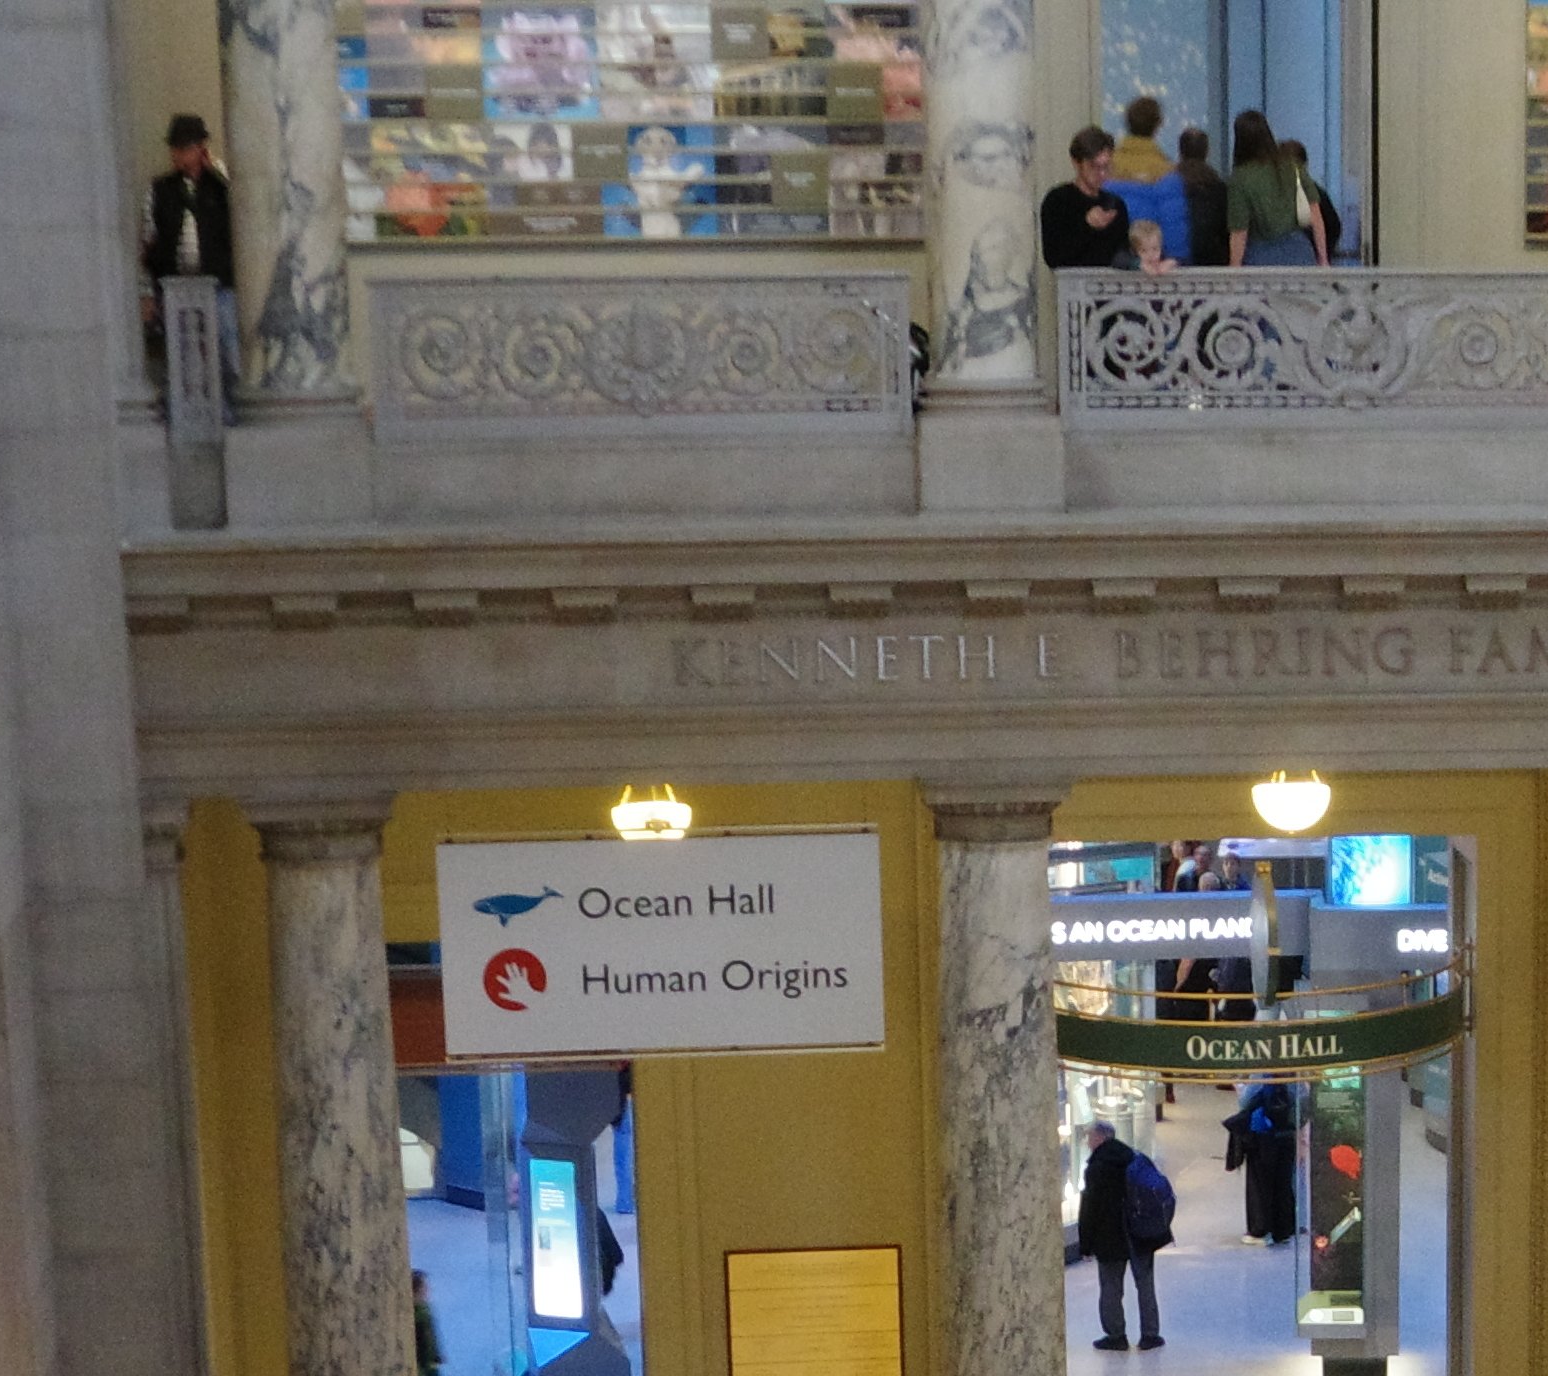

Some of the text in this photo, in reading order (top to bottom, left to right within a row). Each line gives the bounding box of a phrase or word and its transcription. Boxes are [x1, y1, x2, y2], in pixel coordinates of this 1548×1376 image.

[671, 635, 997, 687] KENNETH
[1113, 624, 1414, 681] BEHRING
[578, 884, 775, 919] Ocean Hall
[1069, 920, 1104, 943] AN
[1106, 919, 1186, 942] OCEAN
[582, 959, 848, 1000] Human Origins
[1186, 1033, 1344, 1062] OCEAN HALL
